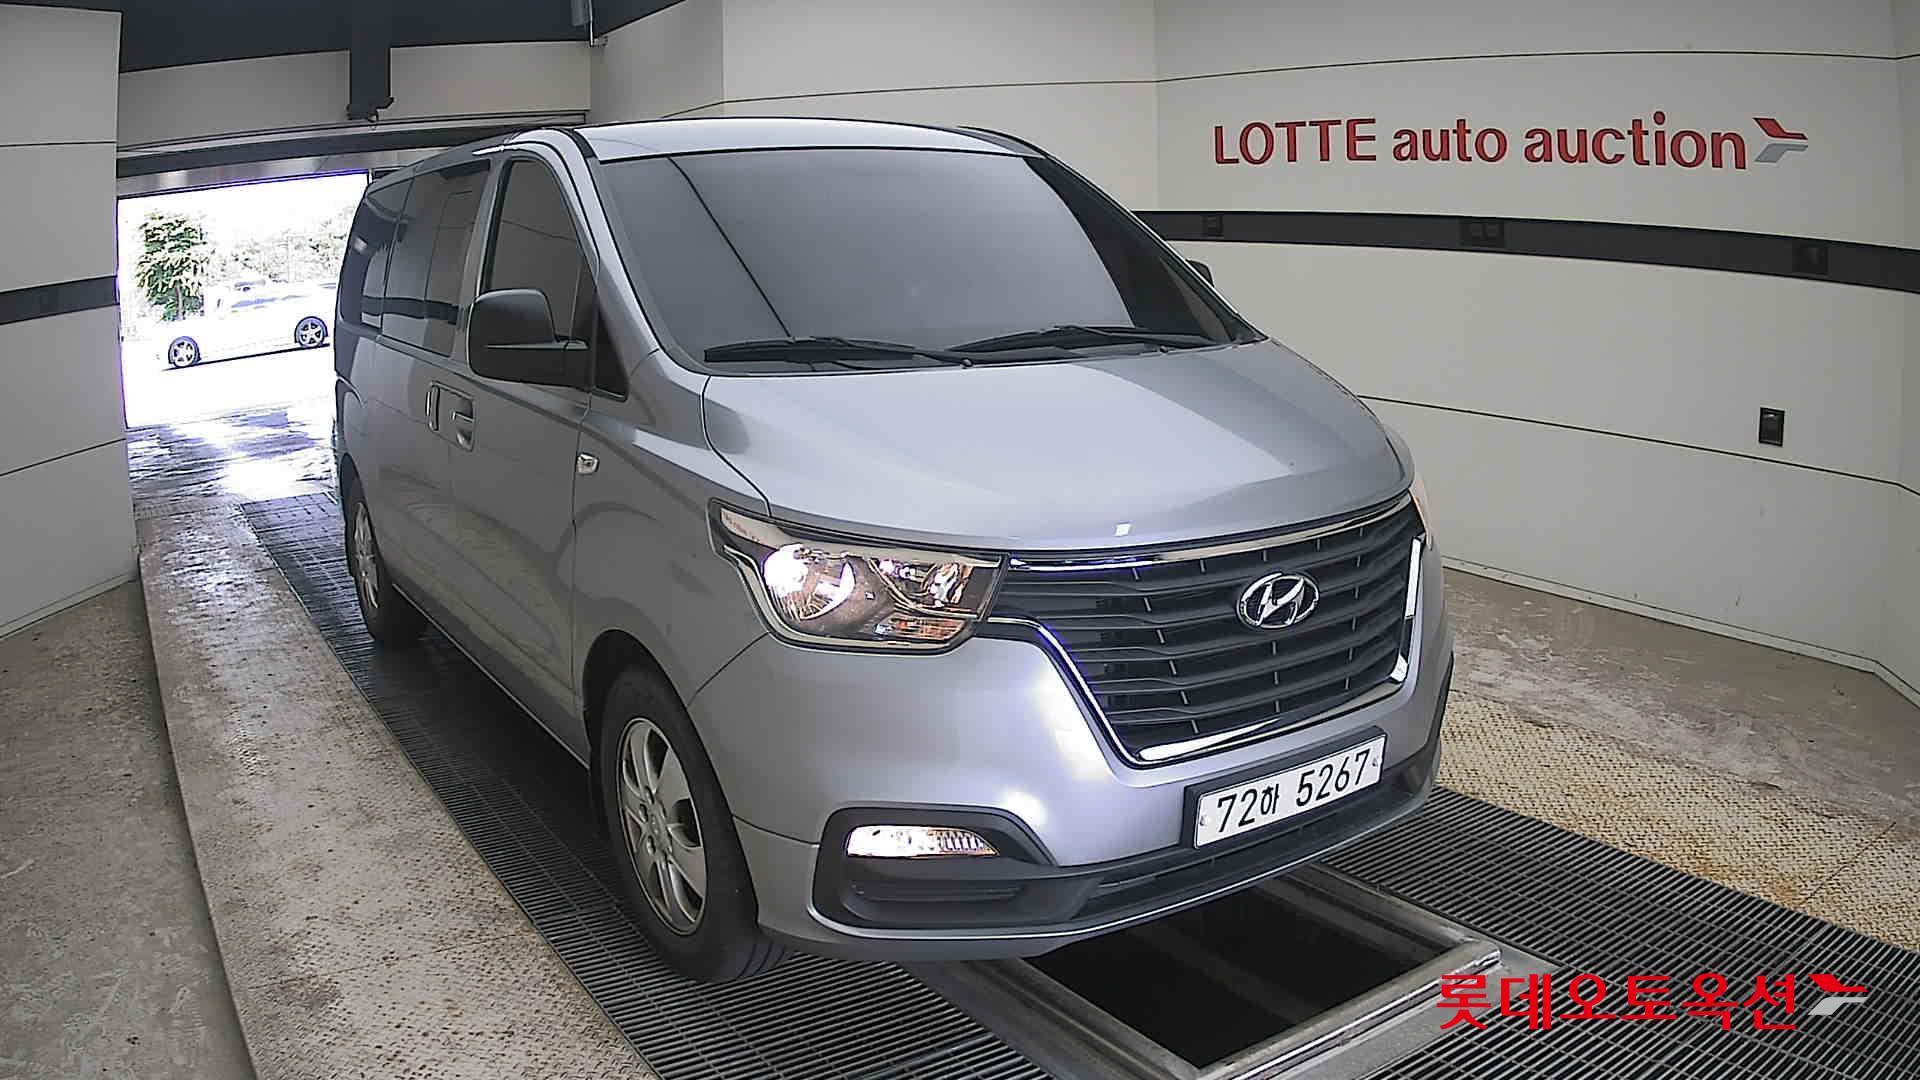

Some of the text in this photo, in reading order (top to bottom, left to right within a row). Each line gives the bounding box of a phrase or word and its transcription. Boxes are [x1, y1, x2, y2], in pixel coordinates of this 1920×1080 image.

[1214, 111, 1746, 170] LOTTE auto auction
[1217, 748, 1371, 833] 72하 5267
